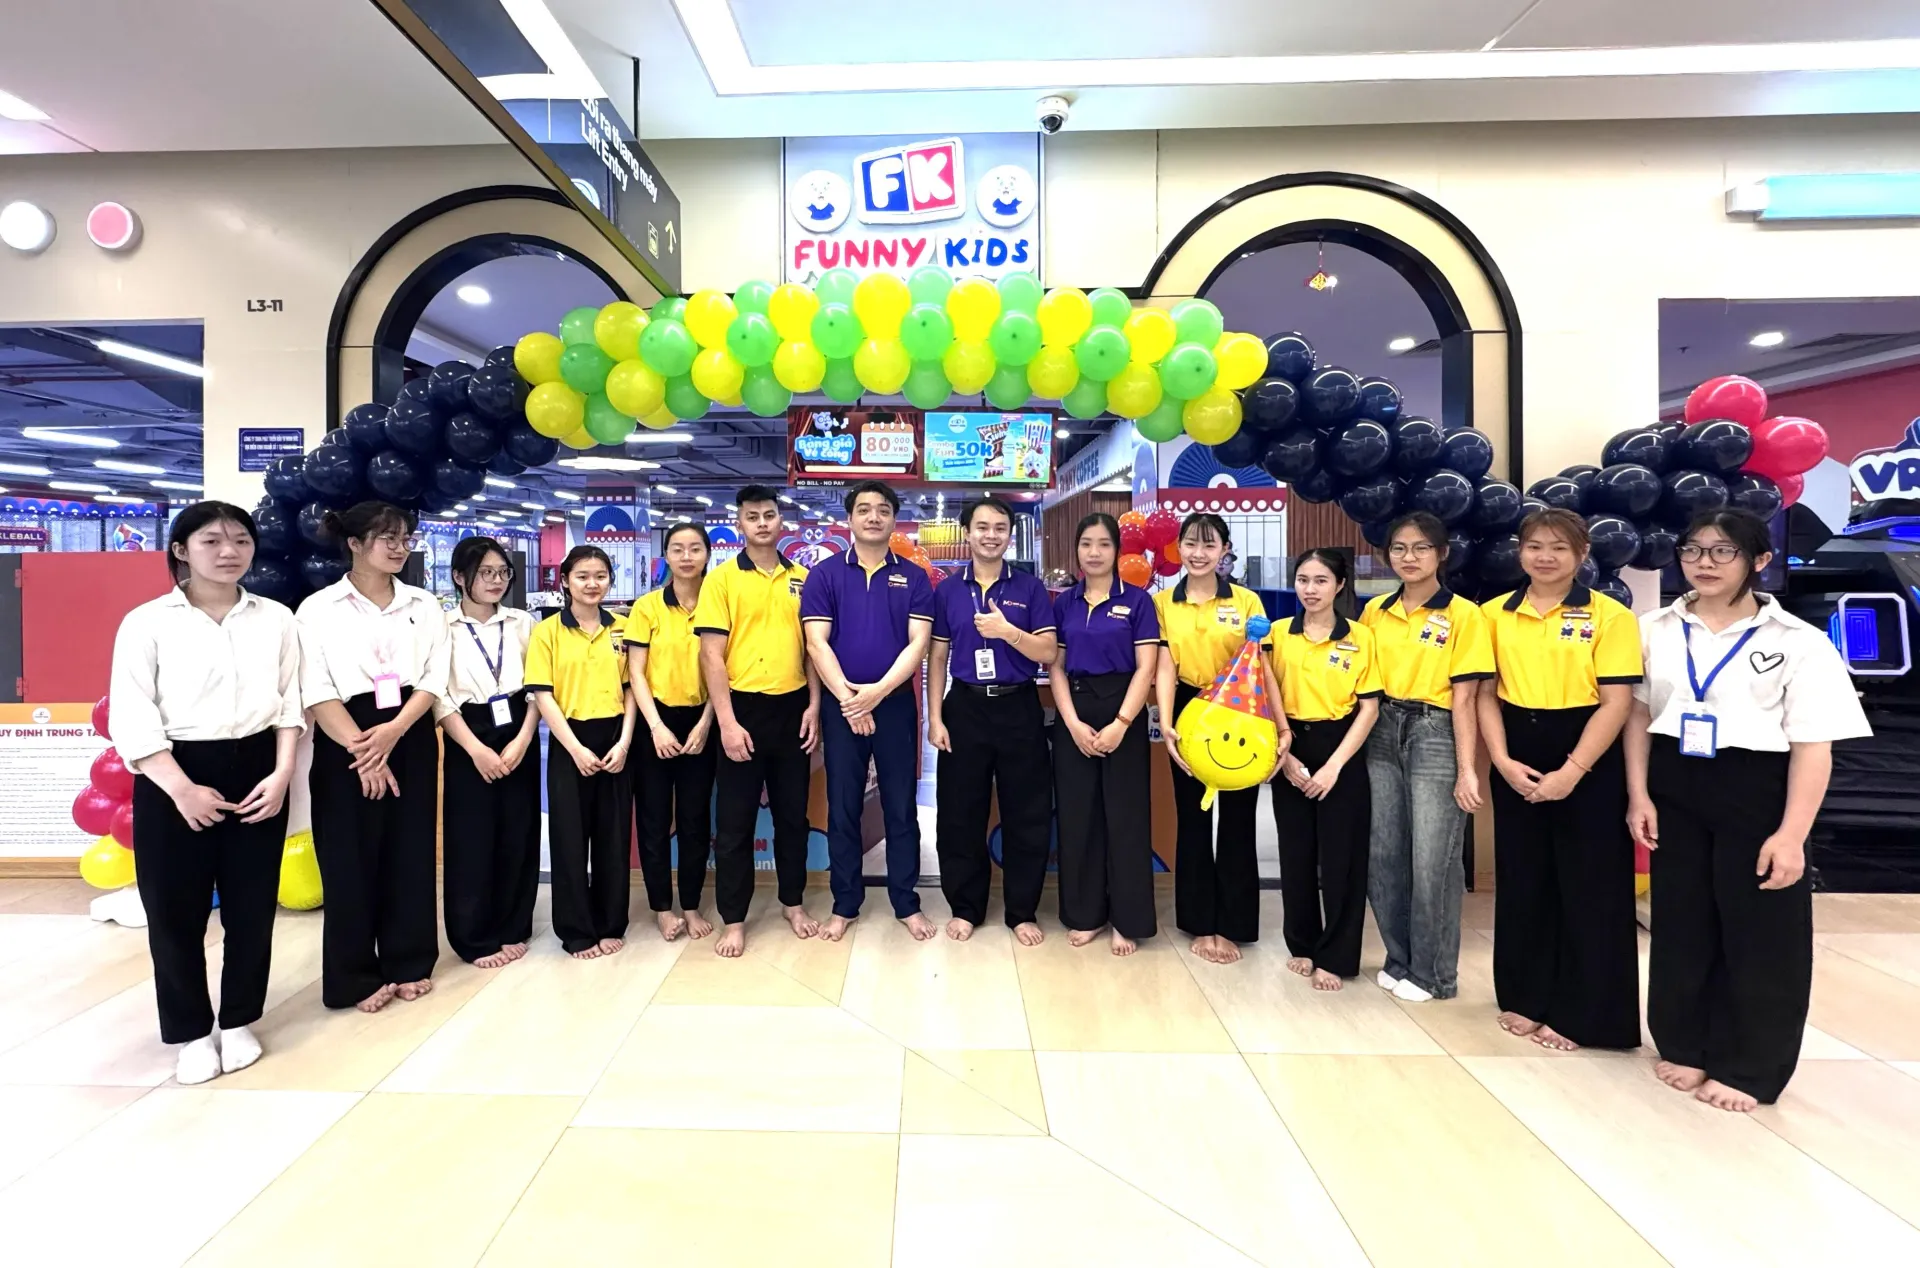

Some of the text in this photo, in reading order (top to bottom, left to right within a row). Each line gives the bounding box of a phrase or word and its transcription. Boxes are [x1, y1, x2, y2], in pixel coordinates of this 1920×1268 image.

[581, 112, 628, 192] Lift Entry
[600, 112, 611, 140] ra
[612, 125, 639, 181] thang
[640, 166, 658, 203] máy
[869, 152, 953, 209] FK
[794, 237, 1029, 270] FUNNY KIDS
[247, 299, 283, 312] L3-11
[866, 436, 890, 452] 80
[1076, 450, 1099, 485] COFFEE
[0, 729, 12, 738] UY
[15, 729, 44, 740] ĐỊNH
[46, 728, 84, 737] TRUNG
